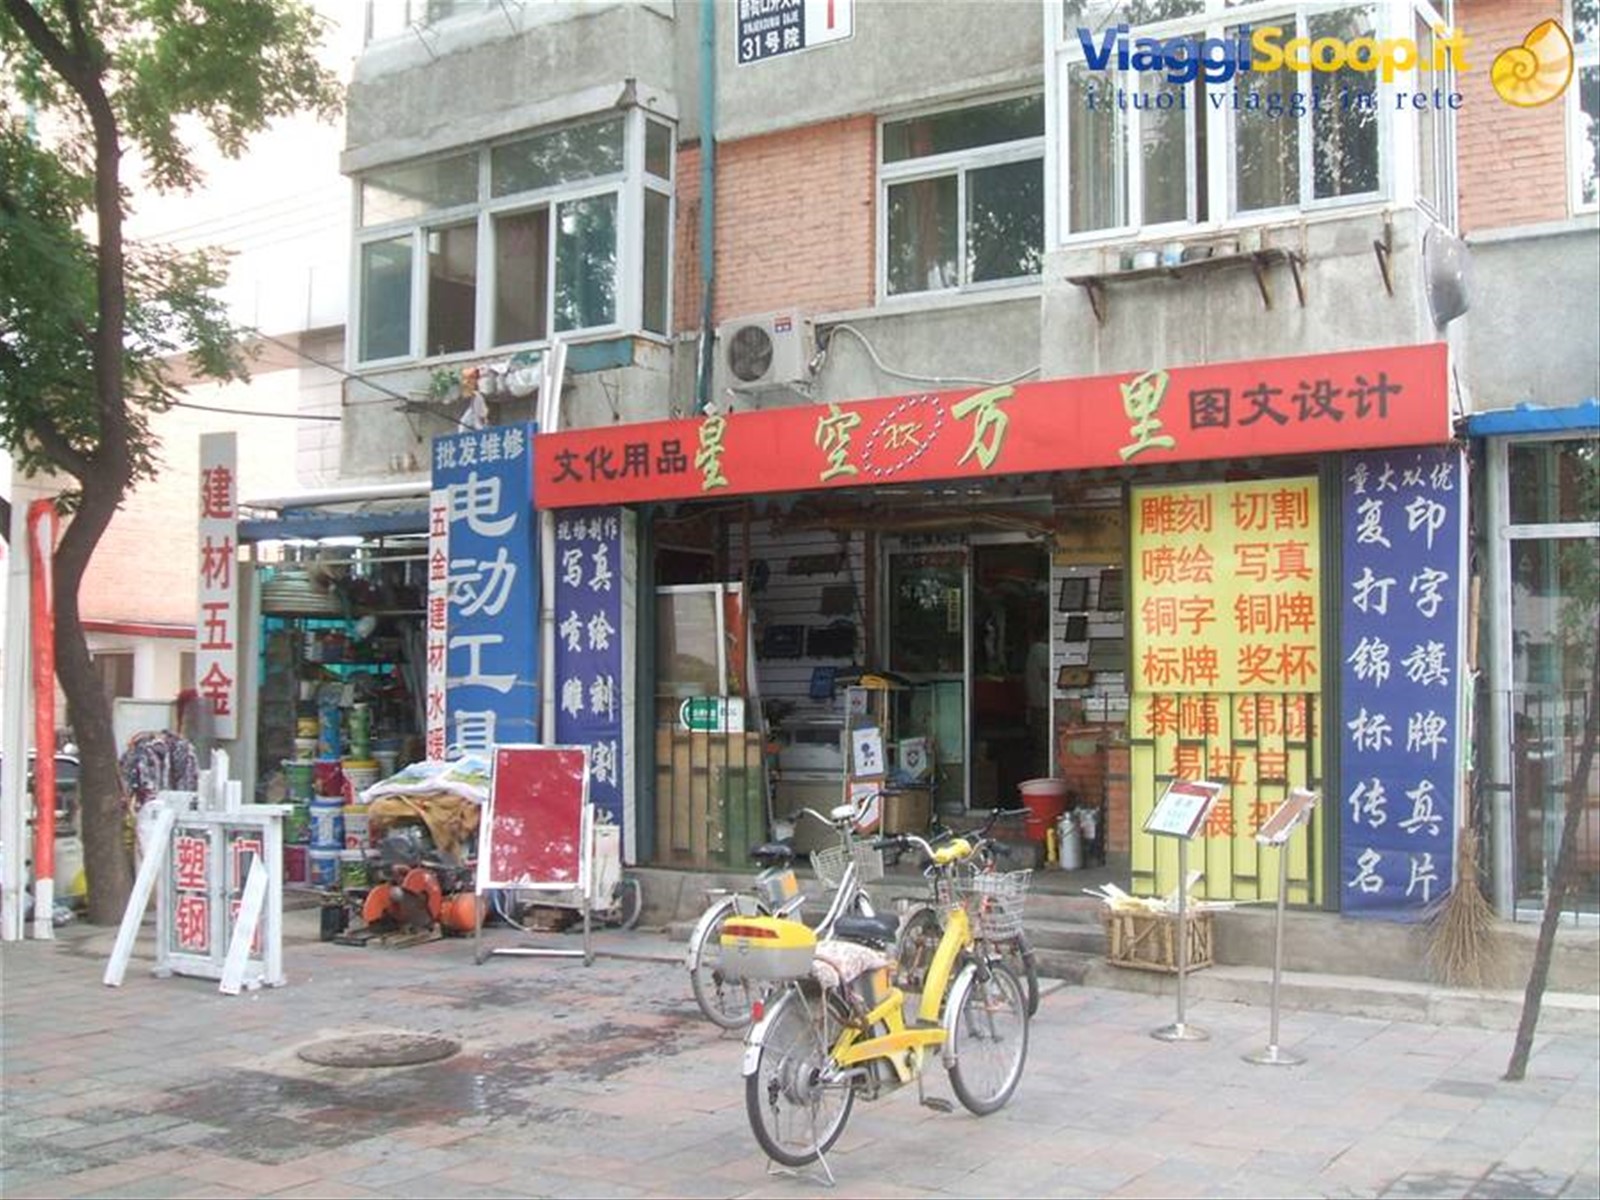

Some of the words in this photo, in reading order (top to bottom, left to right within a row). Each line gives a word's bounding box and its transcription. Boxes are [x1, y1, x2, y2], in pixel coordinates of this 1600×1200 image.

[436, 428, 525, 471] 批发维修
[552, 438, 687, 485] 文化用品
[1188, 373, 1403, 431] 图文设计
[1140, 492, 1213, 536] 雕刻
[1231, 486, 1309, 531] 切割
[1357, 496, 1447, 550] 复印
[1141, 545, 1215, 586] 喷绘
[1234, 540, 1313, 582] 写真
[200, 464, 234, 717] 建材五金
[1141, 596, 1217, 637] 铜字
[1234, 593, 1316, 635] 铜牌
[1352, 567, 1449, 619] 打字
[1142, 645, 1219, 688] 标牌
[1238, 643, 1317, 687] 奖杯
[1145, 695, 1220, 737] 条幅
[176, 836, 207, 950] 塑钢
